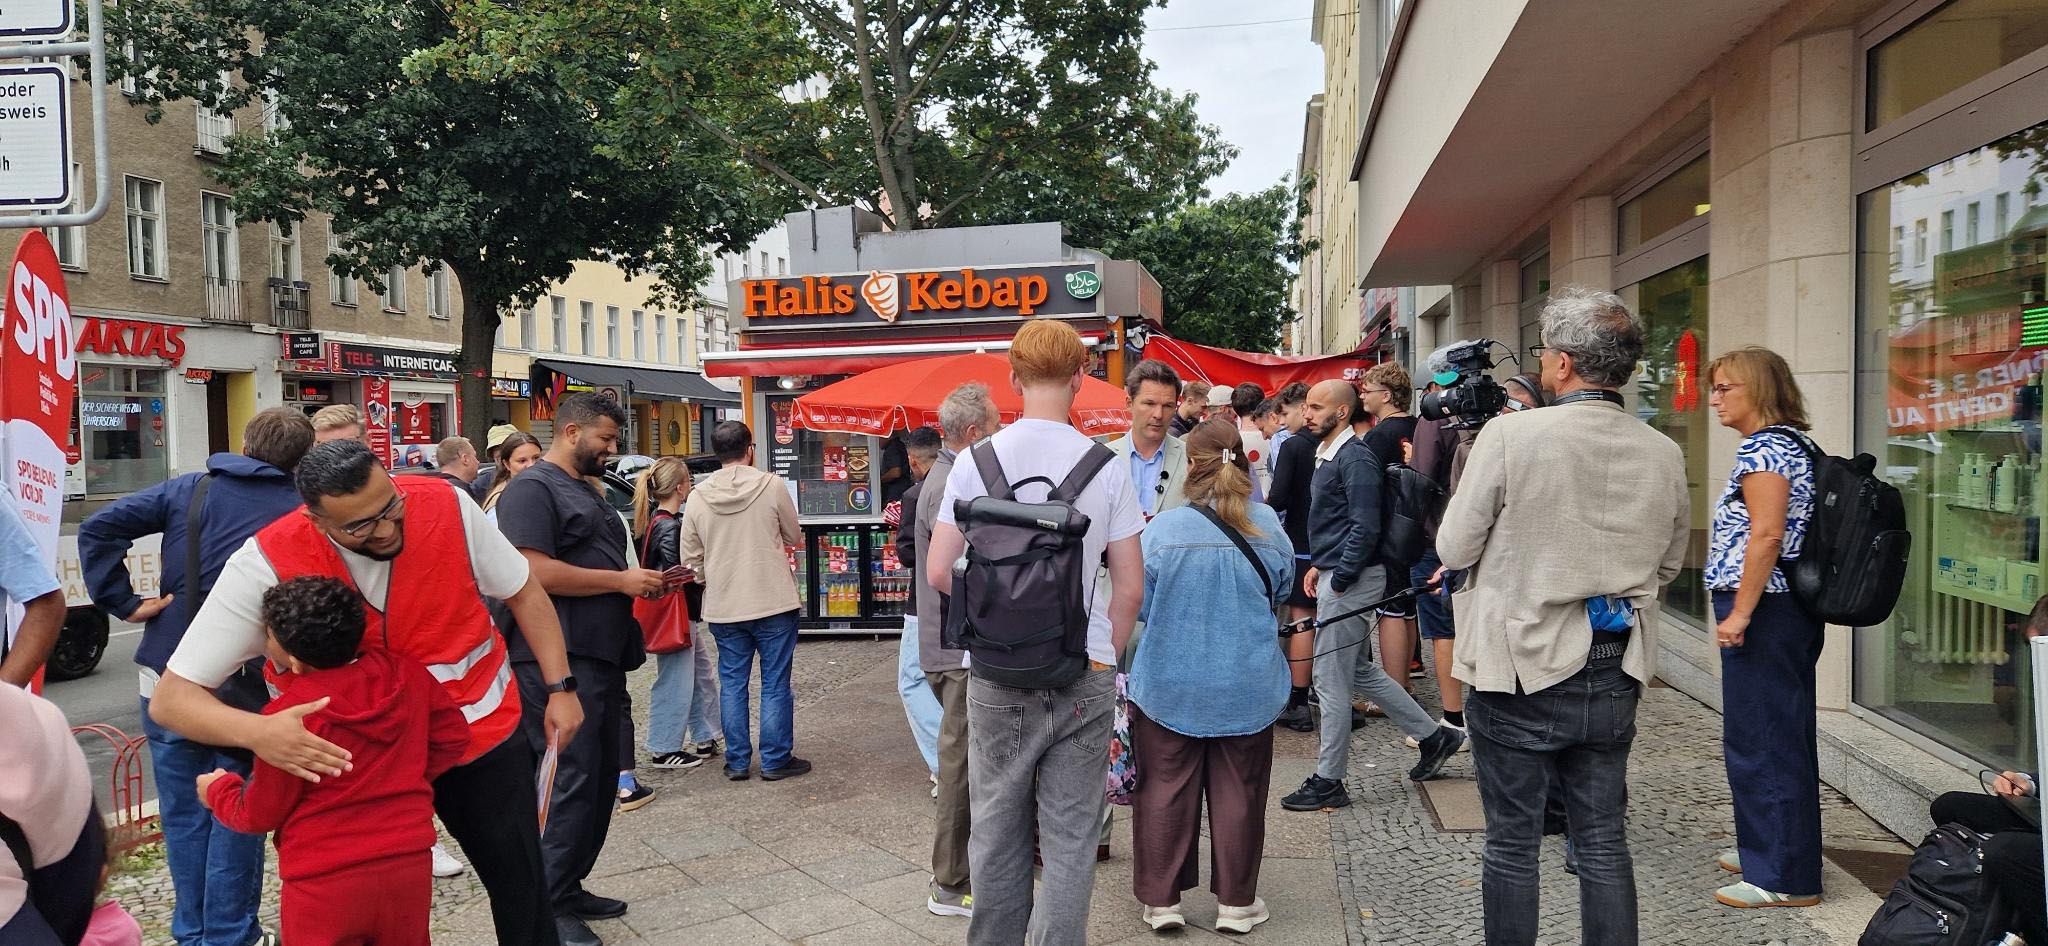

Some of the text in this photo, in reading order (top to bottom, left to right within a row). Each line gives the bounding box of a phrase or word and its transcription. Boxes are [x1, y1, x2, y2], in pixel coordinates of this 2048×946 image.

[741, 268, 1048, 317] Halis Kebap
[13, 260, 75, 381] SPD
[74, 316, 186, 368] AKTAŞ
[345, 351, 374, 366] TELE
